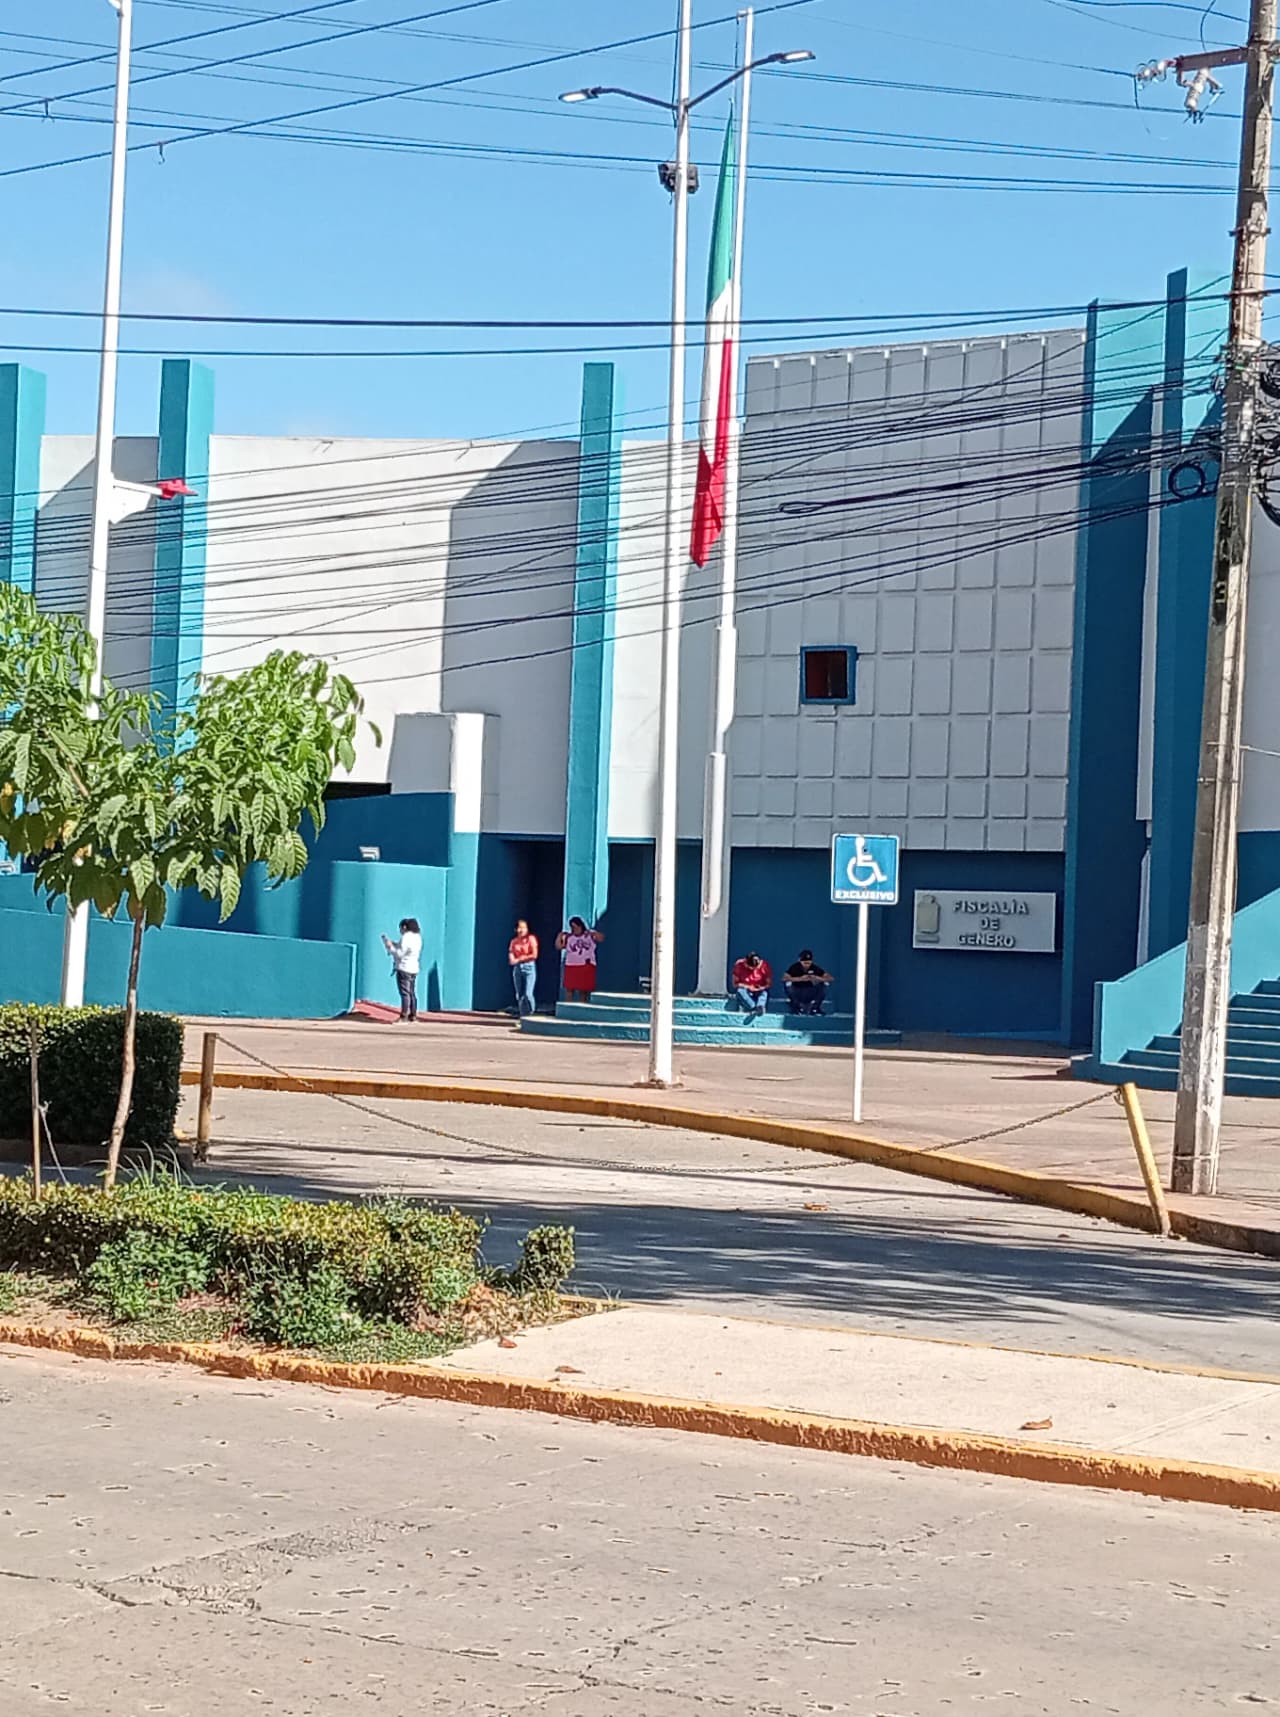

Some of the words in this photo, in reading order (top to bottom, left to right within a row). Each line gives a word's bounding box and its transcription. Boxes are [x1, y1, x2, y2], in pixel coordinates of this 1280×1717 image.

[835, 890, 895, 900] EXCLUSIVO
[953, 899, 1029, 915] FISCALÍA
[980, 918, 1000, 931] DE
